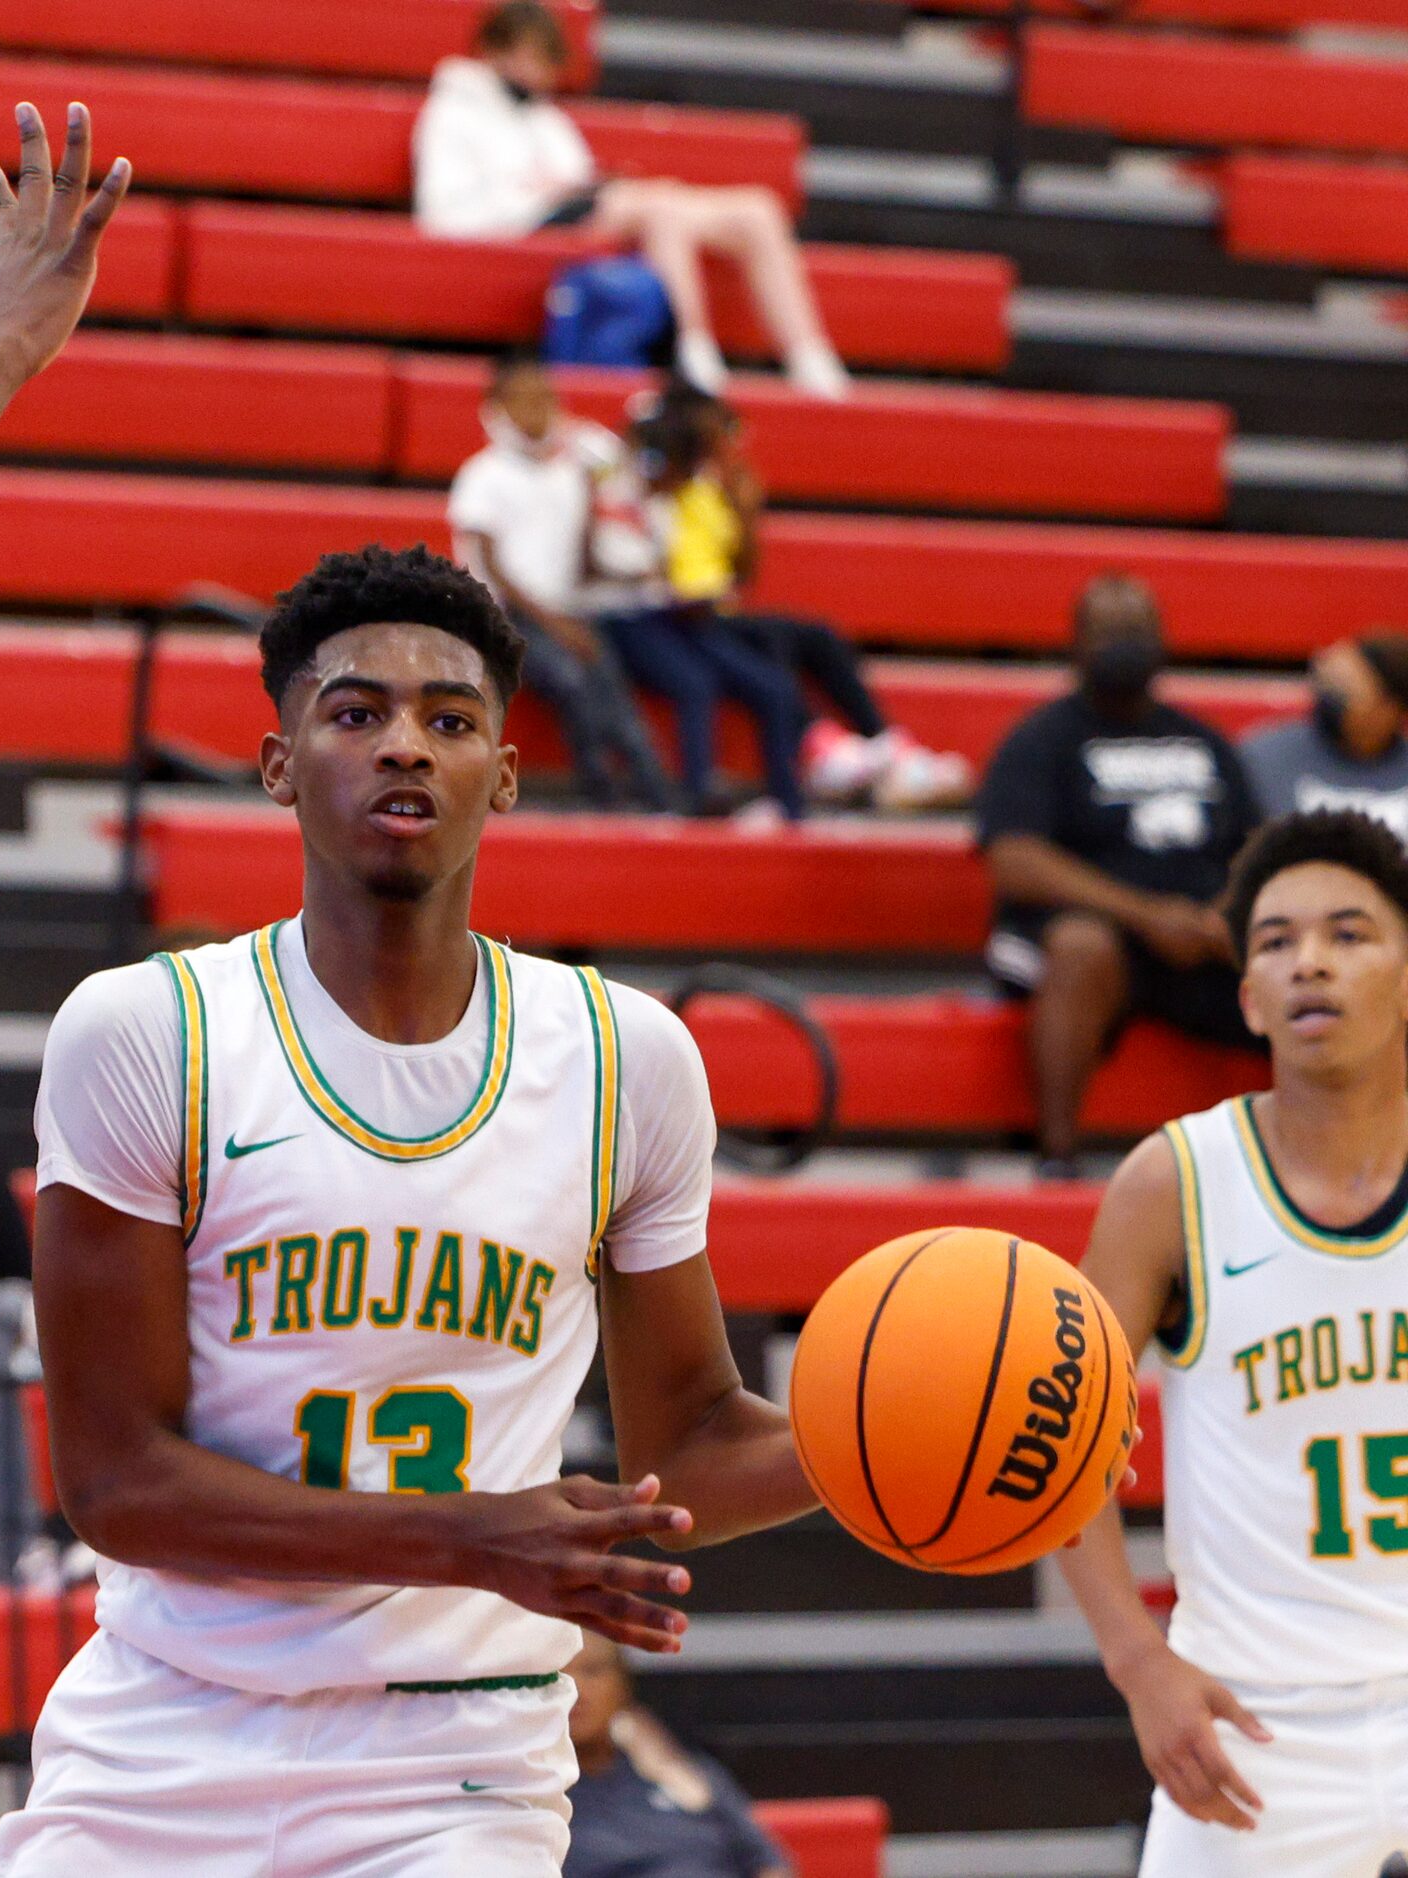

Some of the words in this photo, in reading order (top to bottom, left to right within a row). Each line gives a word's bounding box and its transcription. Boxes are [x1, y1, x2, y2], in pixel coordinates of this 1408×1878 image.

[223, 1226, 557, 1358] TROJANS
[294, 1385, 474, 1496] 13
[986, 1286, 1086, 1503] Wilson
[1303, 1431, 1408, 1561] 15
